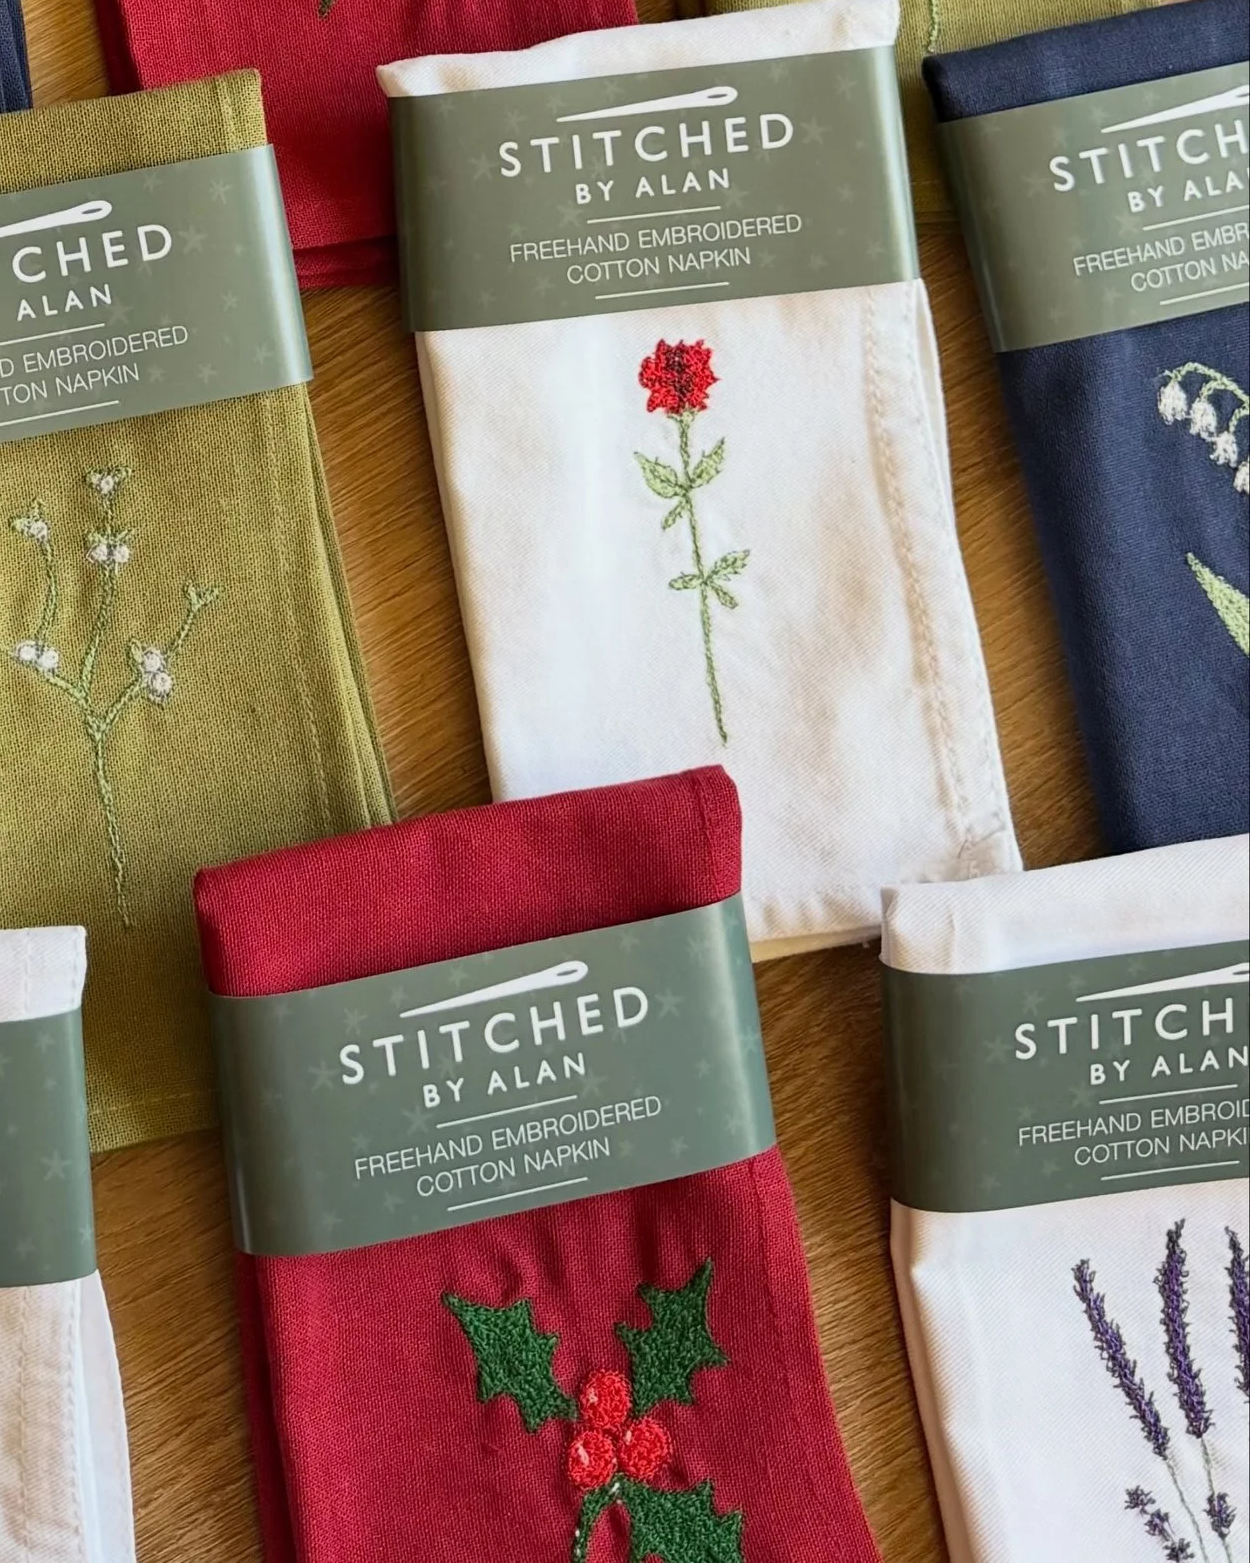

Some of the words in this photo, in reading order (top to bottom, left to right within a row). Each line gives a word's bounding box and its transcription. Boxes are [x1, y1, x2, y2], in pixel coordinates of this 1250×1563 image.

[499, 113, 794, 177] STITCHED
[1049, 119, 1248, 192] STITCH
[575, 180, 614, 205] BY
[635, 167, 730, 198] ALAN
[1127, 185, 1163, 213] BY
[1184, 167, 1249, 202] ALA
[510, 232, 630, 263] FREEHAND
[638, 214, 802, 249] EMBROIDERED
[1073, 236, 1185, 276] FREEHAND
[567, 256, 660, 284] COTTON
[668, 246, 751, 273] NAPKIN
[1131, 257, 1216, 292] COTTON
[17, 283, 112, 322] ALAN
[22, 325, 188, 373] EMBROIDERED
[55, 362, 139, 396] NAPKIN
[339, 986, 648, 1085] STITCHED
[1014, 997, 1234, 1060] STITCH
[423, 1077, 464, 1108] BY
[487, 1052, 585, 1095] ALAN
[1090, 1059, 1131, 1085] BY
[1151, 1046, 1248, 1077] ALAN
[354, 1134, 483, 1180] FREEHAND
[491, 1095, 662, 1150] EMBROIDERED
[1018, 1112, 1142, 1146] FREEHAND
[1074, 1135, 1170, 1166] COTTON
[416, 1157, 516, 1197] COTTON
[523, 1136, 610, 1174] NAPKIN
